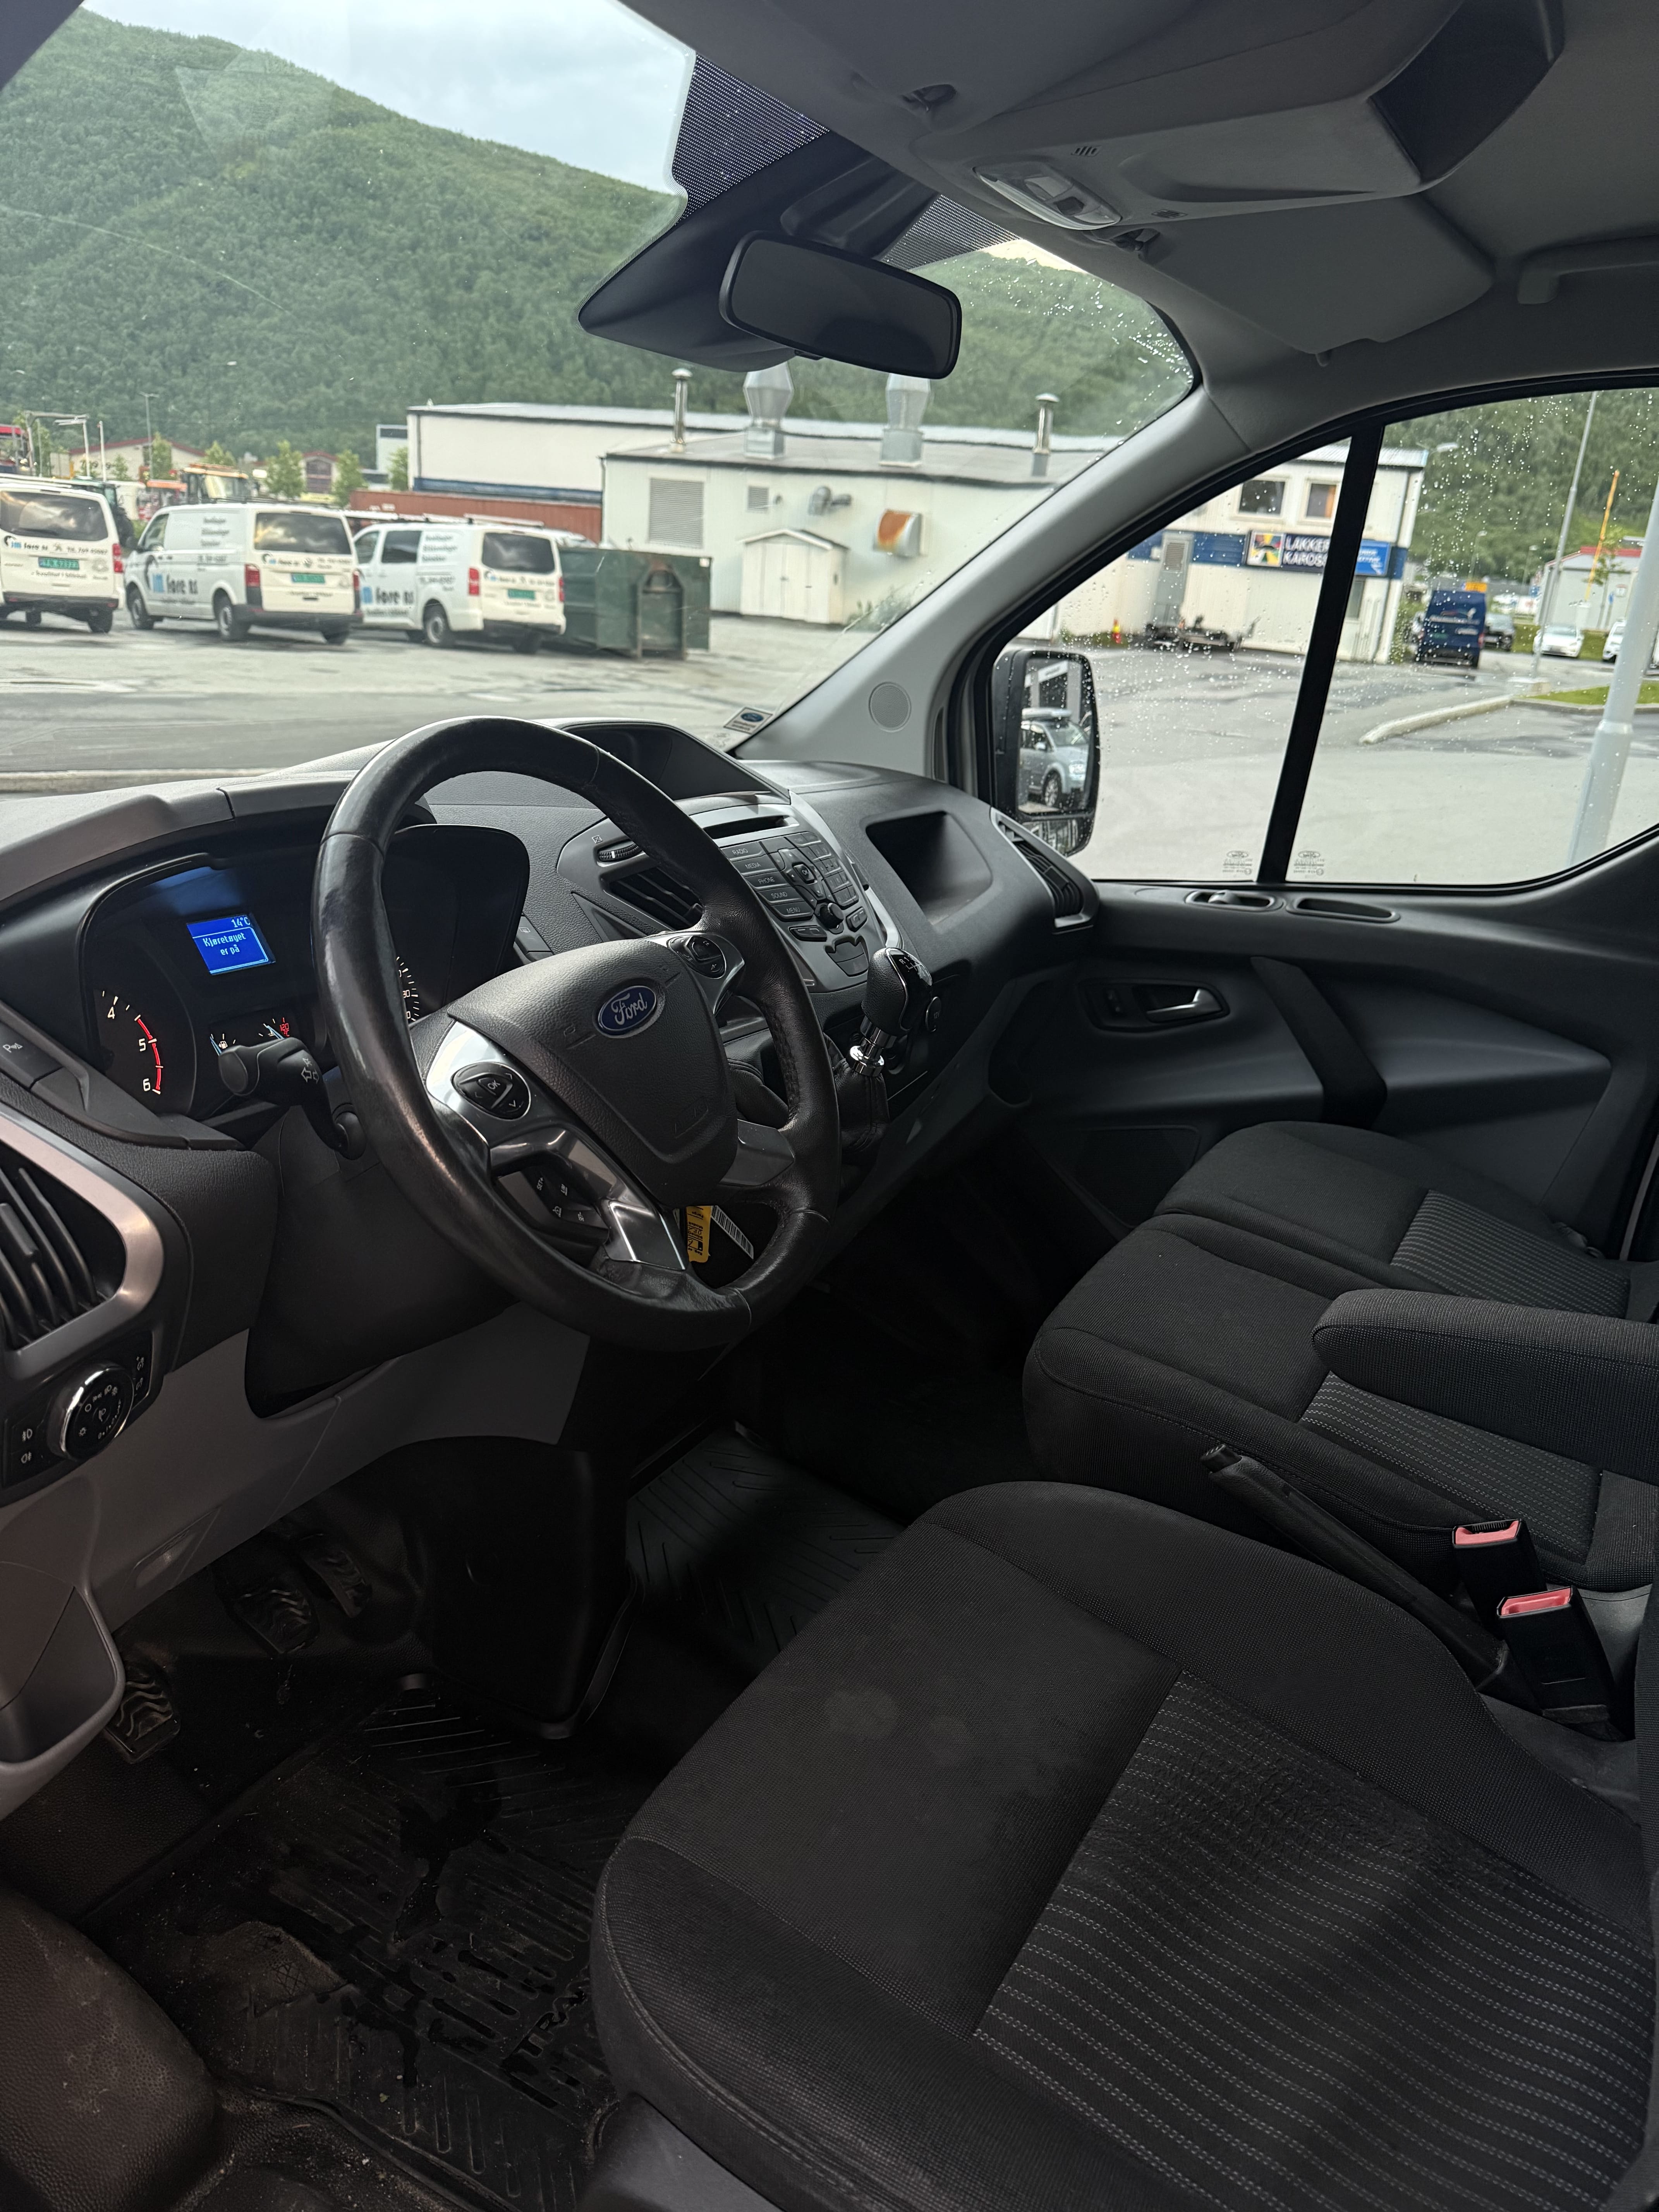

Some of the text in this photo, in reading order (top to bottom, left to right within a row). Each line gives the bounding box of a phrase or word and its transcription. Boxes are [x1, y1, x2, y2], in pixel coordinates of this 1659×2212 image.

[758, 876, 775, 884] PHONE
[771, 891, 788, 899] SOUND
[231, 917, 251, 927] 14°C
[203, 933, 246, 947] Kjøretøyet
[230, 944, 240, 955] på
[107, 1007, 115, 1019] 4
[611, 992, 648, 1025] Ford
[280, 1023, 289, 1032] 120
[138, 1038, 146, 1051] 5
[143, 1078, 151, 1091] 6
[487, 1079, 500, 1089] OK
